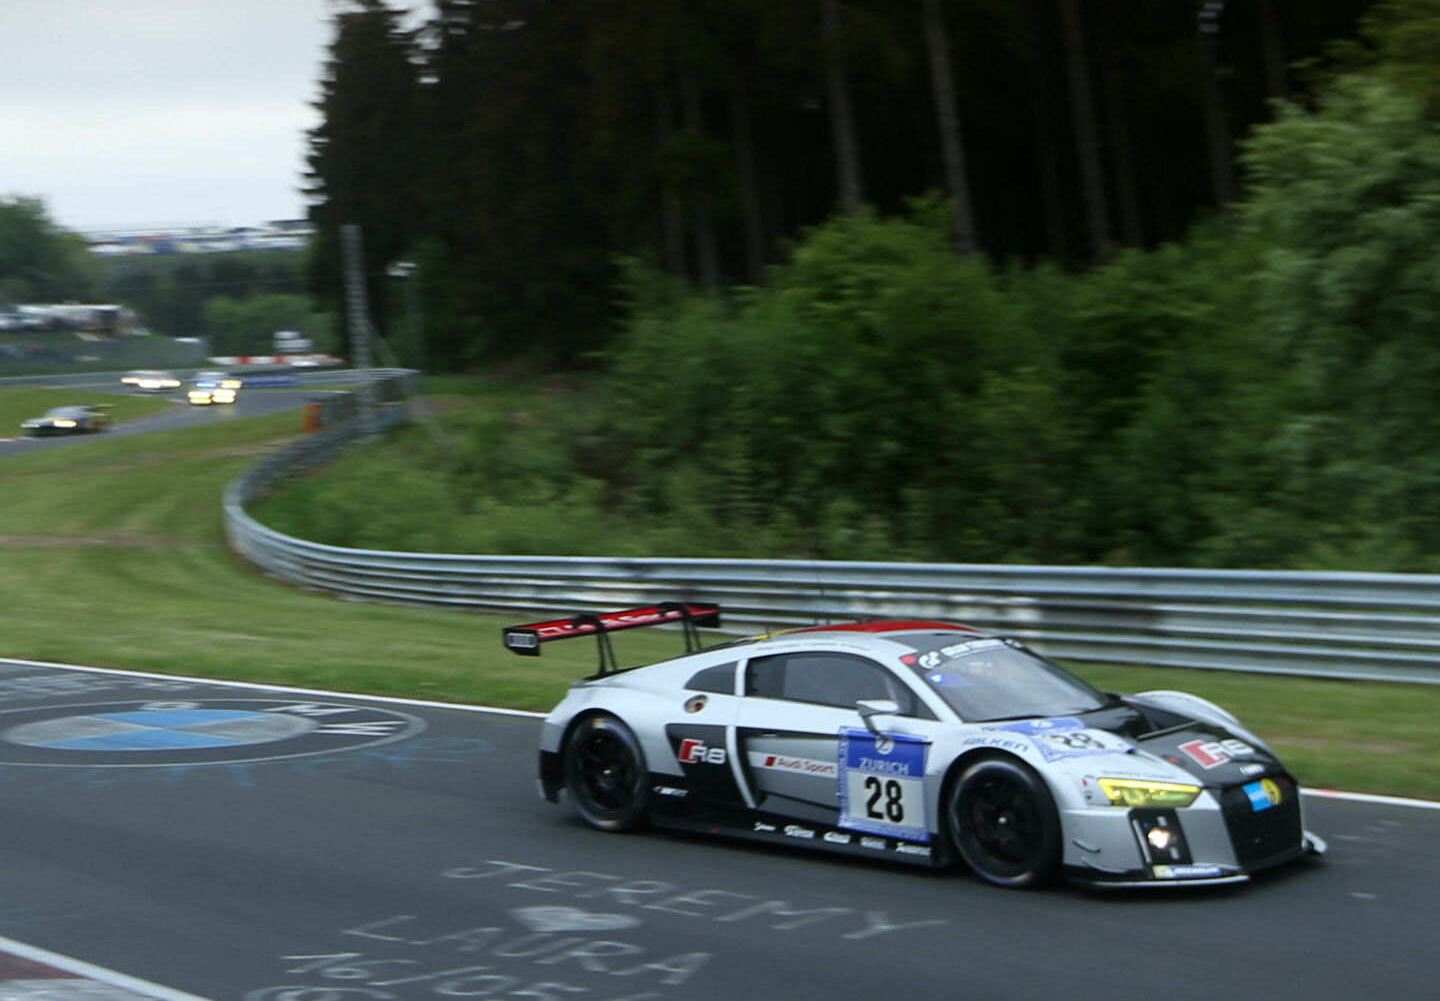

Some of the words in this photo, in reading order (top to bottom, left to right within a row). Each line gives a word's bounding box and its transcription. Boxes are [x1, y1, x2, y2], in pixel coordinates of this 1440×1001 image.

[689, 745, 726, 764] R8
[777, 757, 801, 768] Audi
[802, 760, 836, 774] Sport
[859, 757, 910, 775] ZURICH
[864, 776, 904, 823] 28
[441, 860, 951, 939] JEREMY
[341, 914, 714, 984] LAURA
